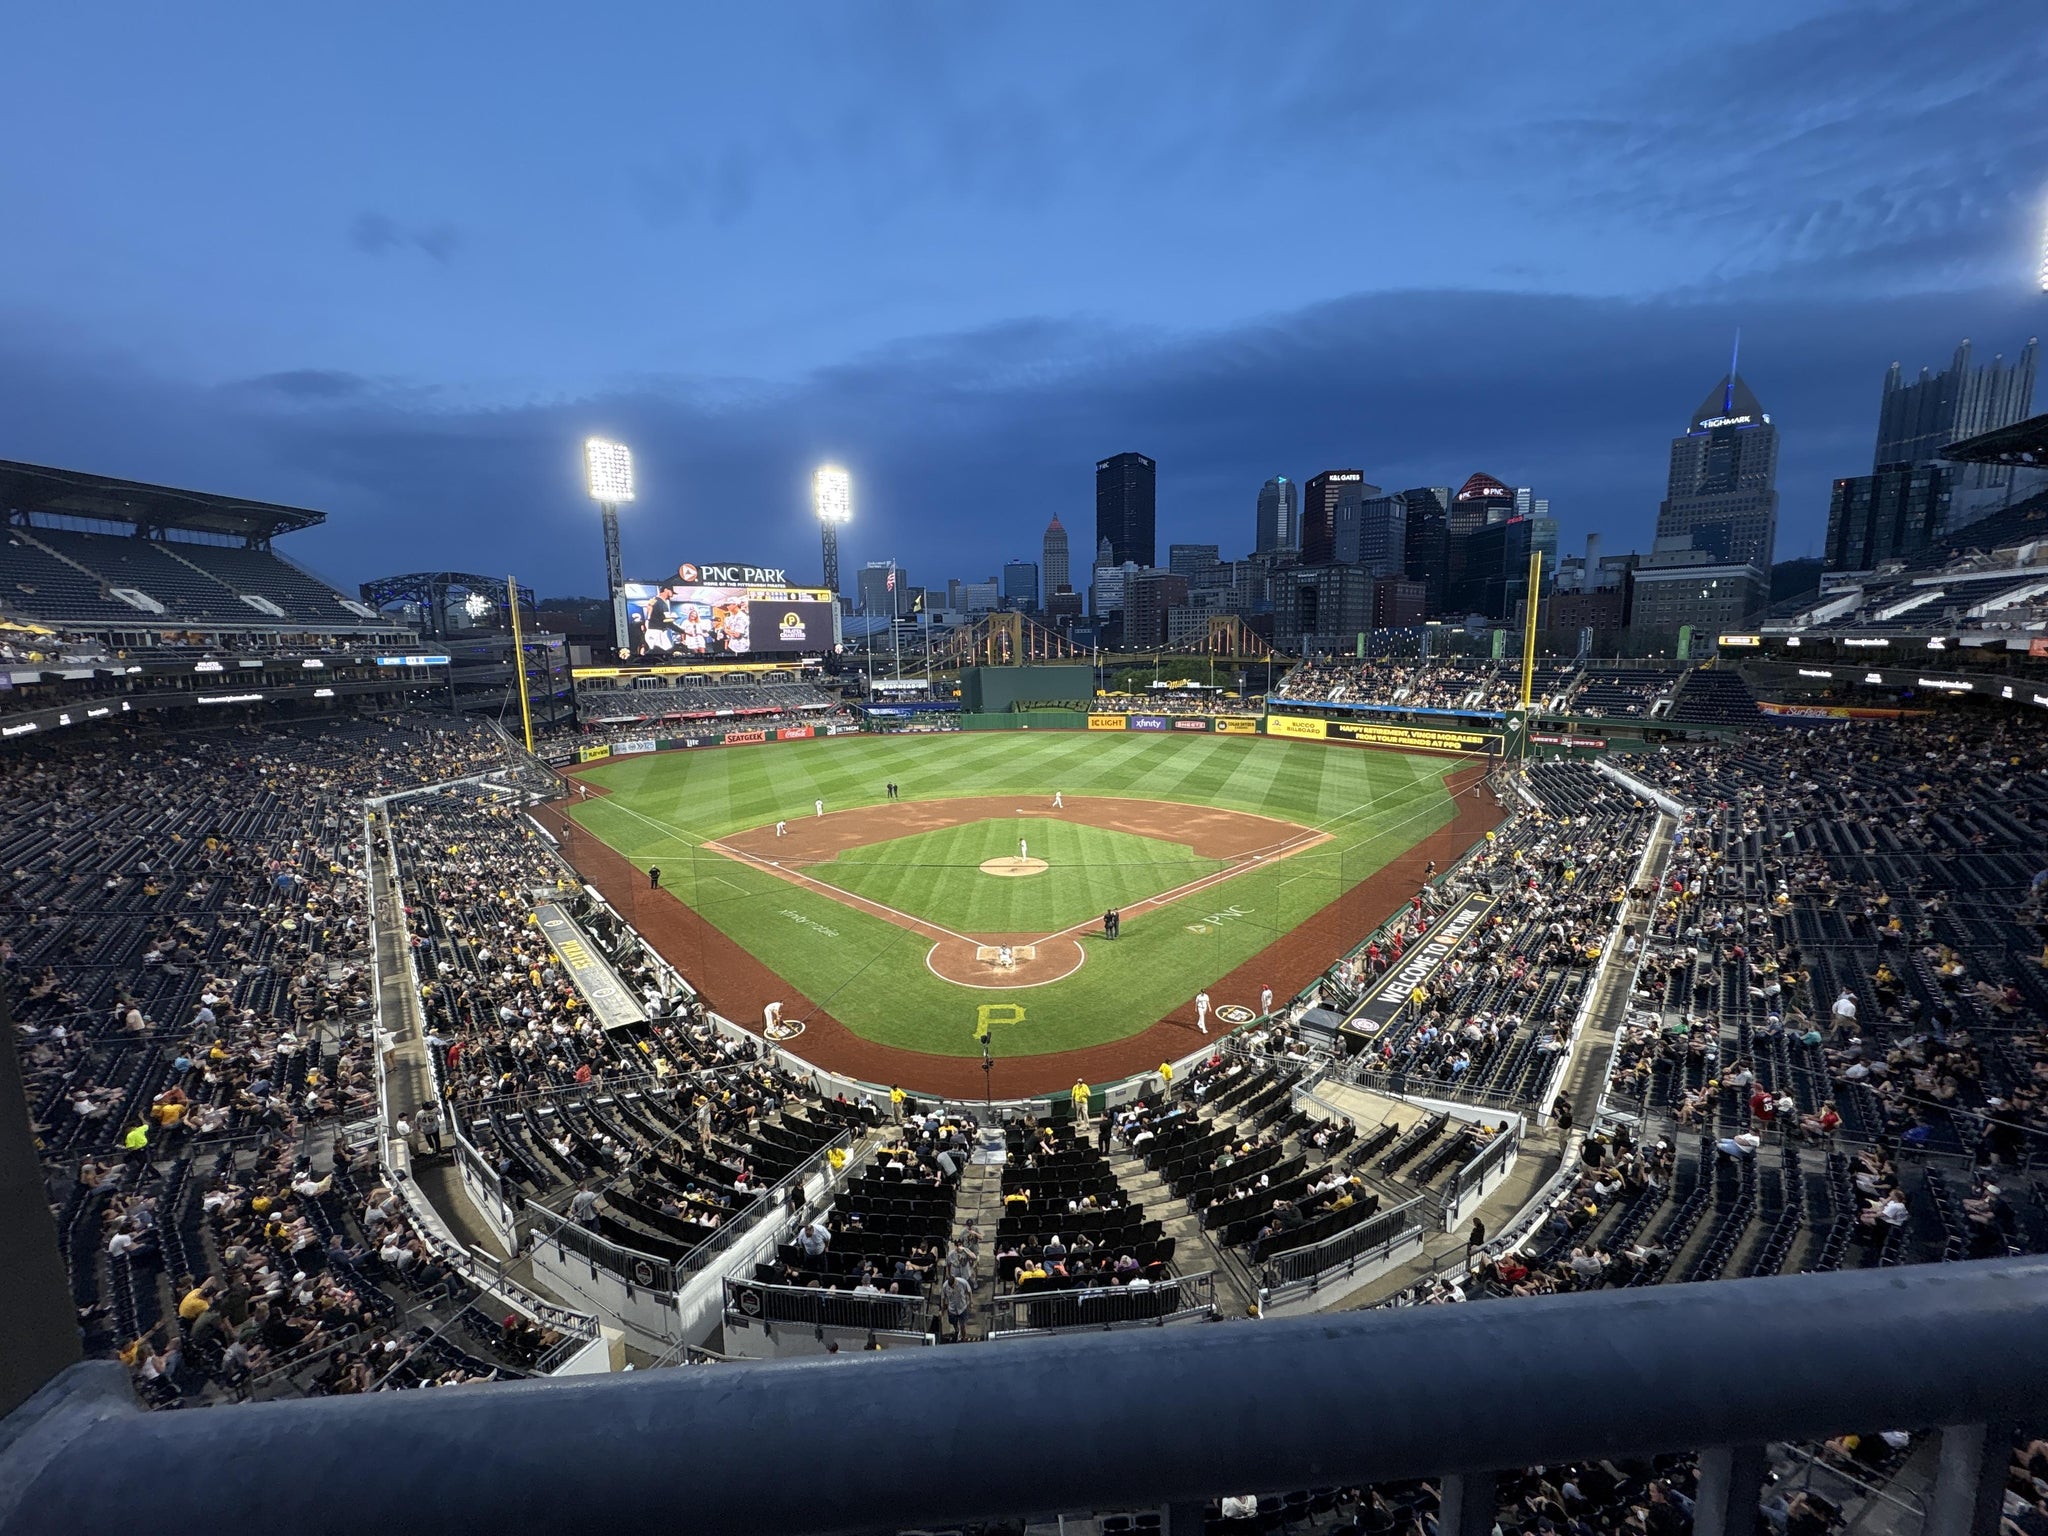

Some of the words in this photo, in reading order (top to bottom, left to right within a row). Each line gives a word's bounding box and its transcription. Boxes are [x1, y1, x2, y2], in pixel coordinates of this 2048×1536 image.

[1703, 415, 1751, 429] HIGHMARK
[1490, 488, 1504, 496] PNC
[700, 566, 740, 582] PNC
[742, 567, 787, 583] PARK
[1786, 706, 1829, 718] Surfside
[1091, 717, 1100, 727] IC
[1101, 716, 1123, 727] LIGHT
[1135, 718, 1162, 729] xfinity
[1291, 721, 1316, 729] BUCCO
[784, 728, 807, 739] Coca-Cola
[836, 725, 860, 734] BETMGM
[1286, 726, 1321, 735] BILLBOARD
[1339, 725, 1364, 734] HAPPY
[1364, 727, 1411, 739] RETIREMENT,
[1411, 731, 1437, 741] VINCE
[727, 732, 763, 743] SEATGEEK
[1355, 733, 1377, 742] FROM
[1376, 735, 1398, 744] YOUR
[1398, 736, 1432, 747] FRIENDS
[1201, 904, 1256, 926] PNC
[1376, 954, 1439, 1004] WELCOME
[1423, 943, 1449, 956] TO
[1453, 908, 1481, 926] PARK
[971, 1003, 1027, 1040] P
